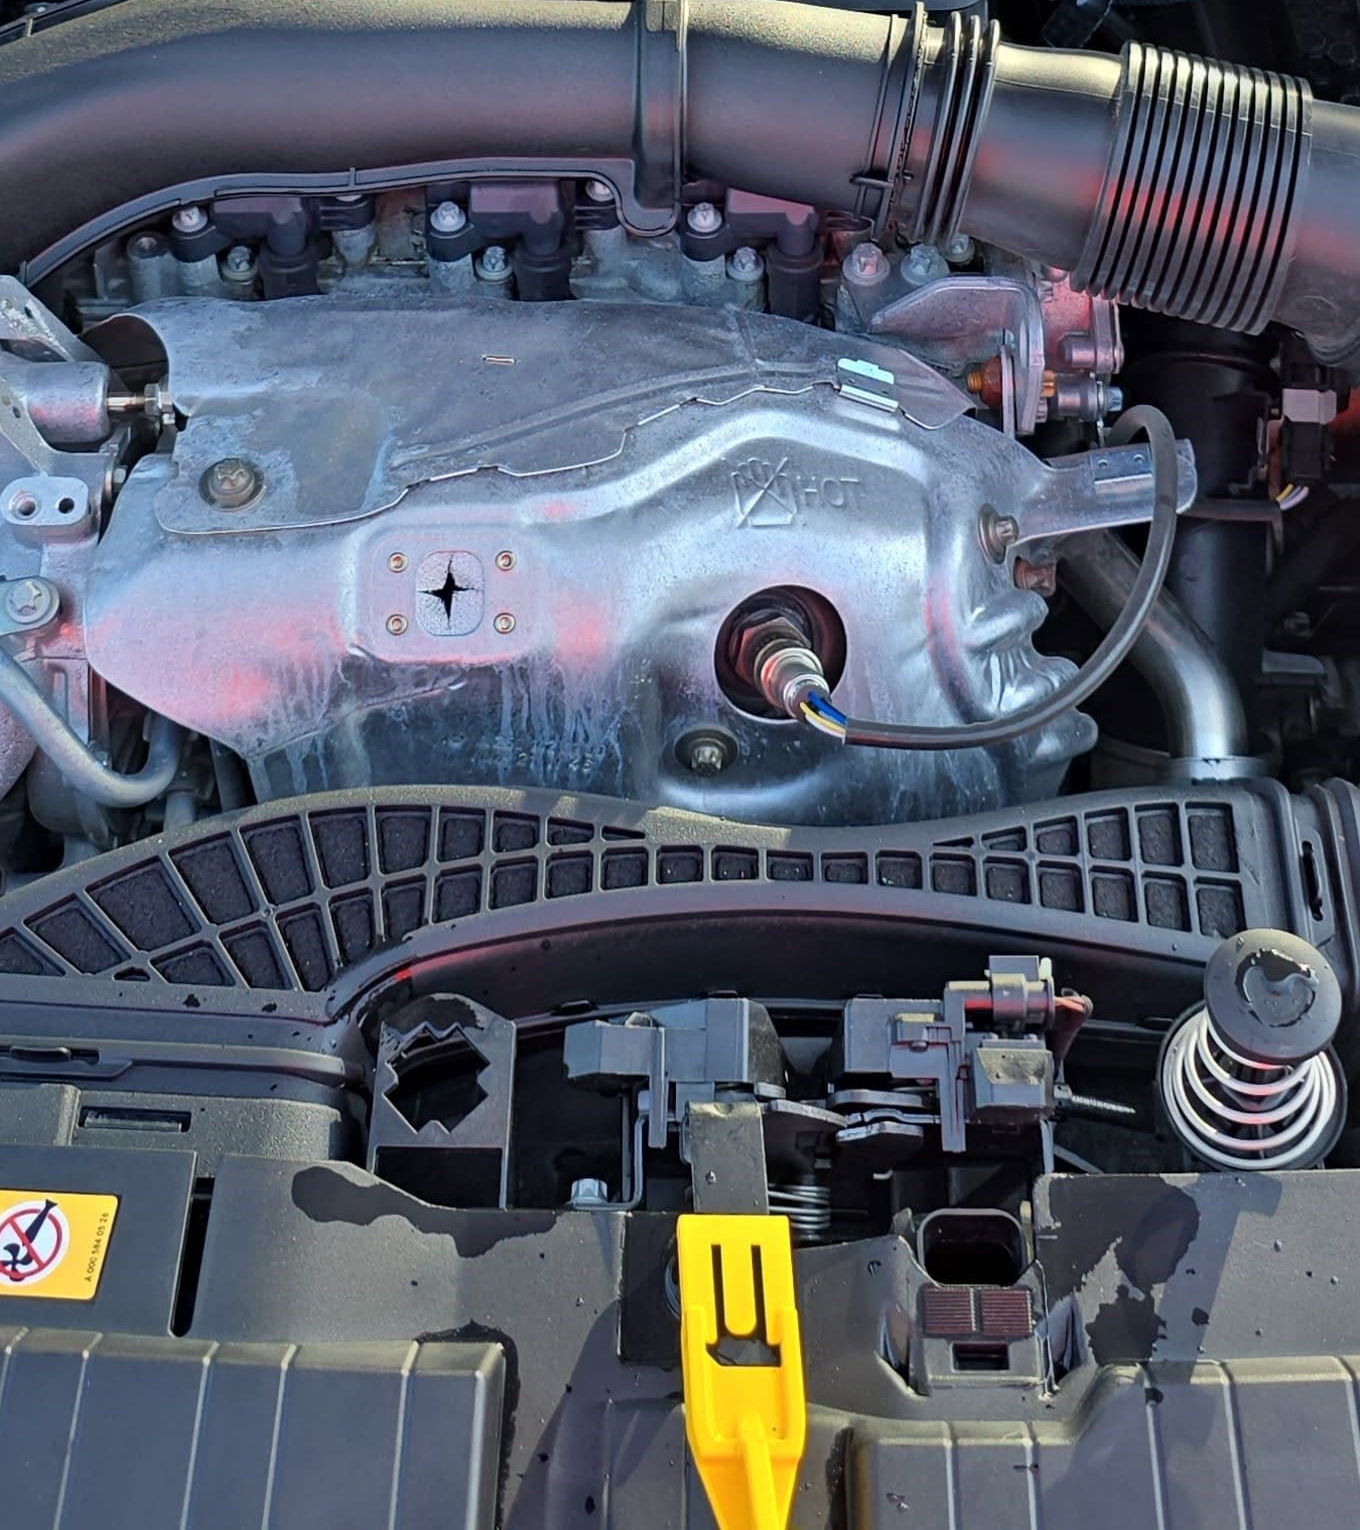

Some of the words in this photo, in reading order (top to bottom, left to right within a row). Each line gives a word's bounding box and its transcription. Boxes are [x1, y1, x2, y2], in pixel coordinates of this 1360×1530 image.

[797, 475, 860, 509] HOT
[100, 1212, 109, 1223] 26
[96, 1225, 105, 1237] 05
[92, 1239, 102, 1255] 584
[87, 1256, 97, 1274] 000
